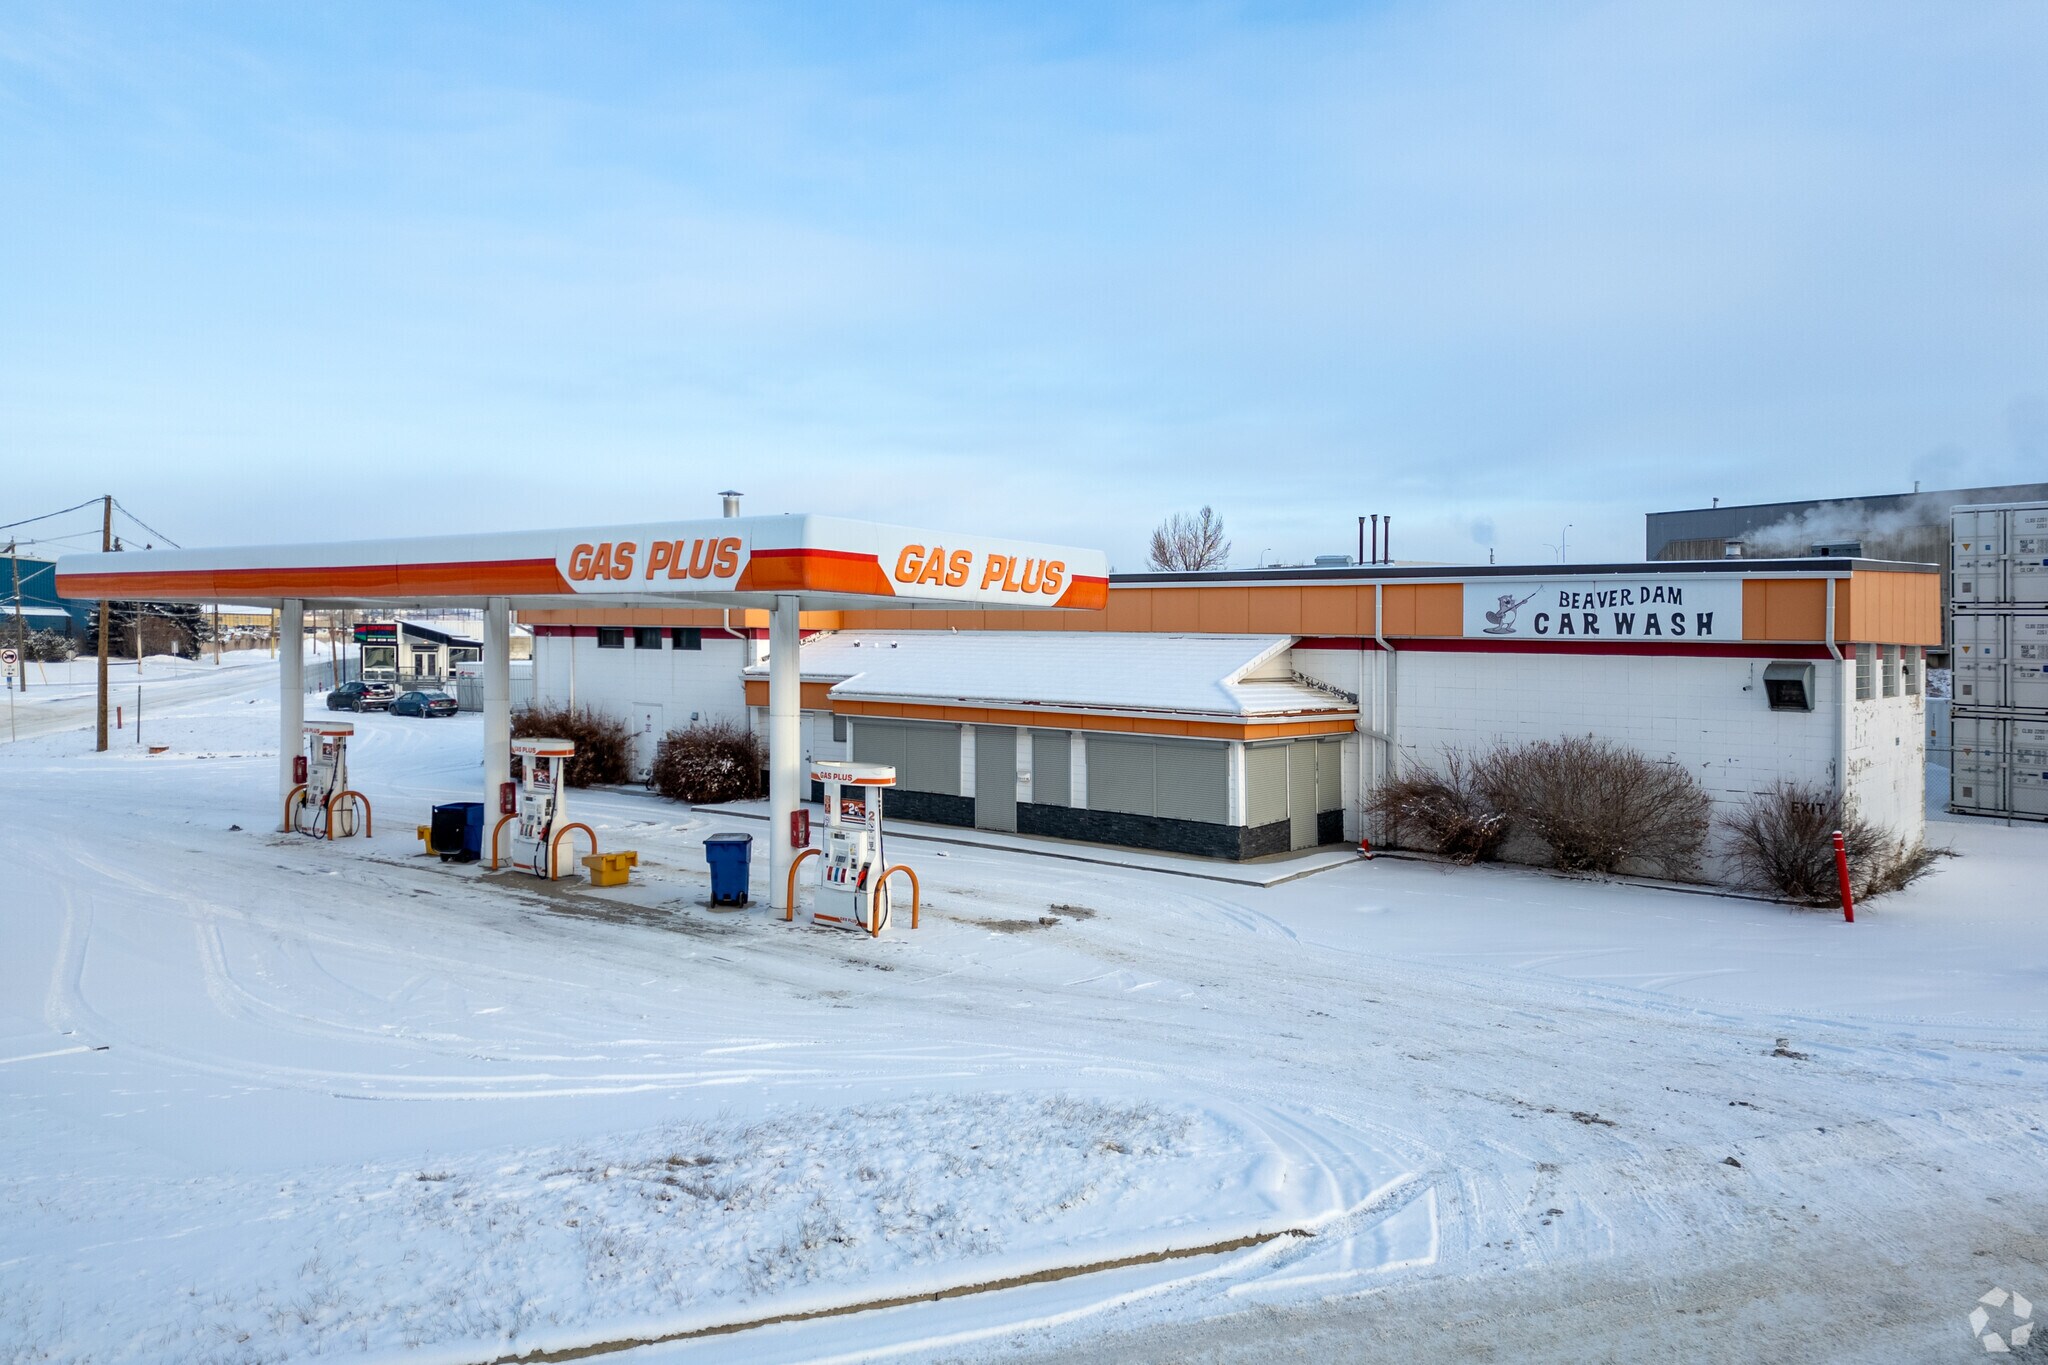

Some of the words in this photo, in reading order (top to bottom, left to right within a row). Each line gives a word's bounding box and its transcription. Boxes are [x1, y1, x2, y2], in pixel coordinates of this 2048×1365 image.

[568, 542, 637, 581] GAS
[645, 536, 742, 580] PLUS
[895, 544, 973, 587] GAS
[980, 553, 1066, 595] PLUS
[1559, 588, 1634, 609] BEAVER
[1640, 586, 1682, 606] DAM
[1534, 612, 1600, 635] CAR
[1614, 612, 1713, 636] WASH
[522, 746, 536, 754] PLUS
[820, 771, 832, 780] GAS
[833, 773, 853, 781] PLUS
[1791, 801, 1826, 815] EXIT
